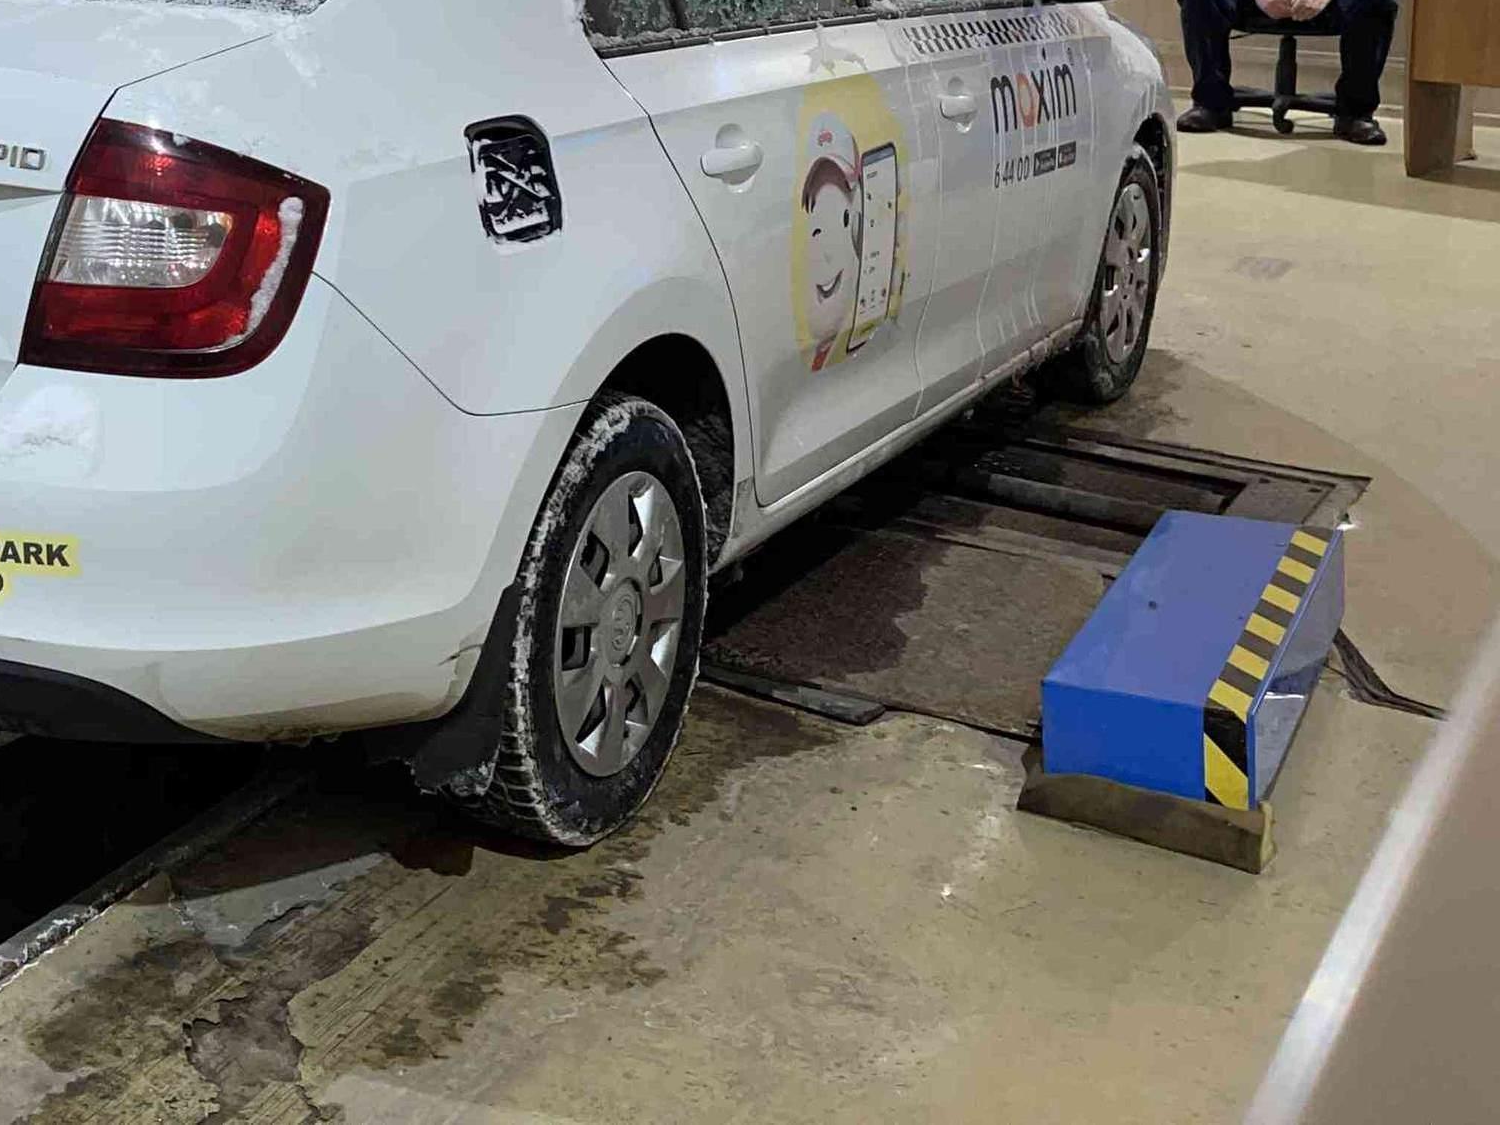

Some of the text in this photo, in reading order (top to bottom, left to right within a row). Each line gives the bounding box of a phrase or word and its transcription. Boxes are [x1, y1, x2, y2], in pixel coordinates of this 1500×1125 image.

[994, 163, 1001, 188] 6
[1002, 159, 1015, 186] 44
[1017, 155, 1030, 182] 00
